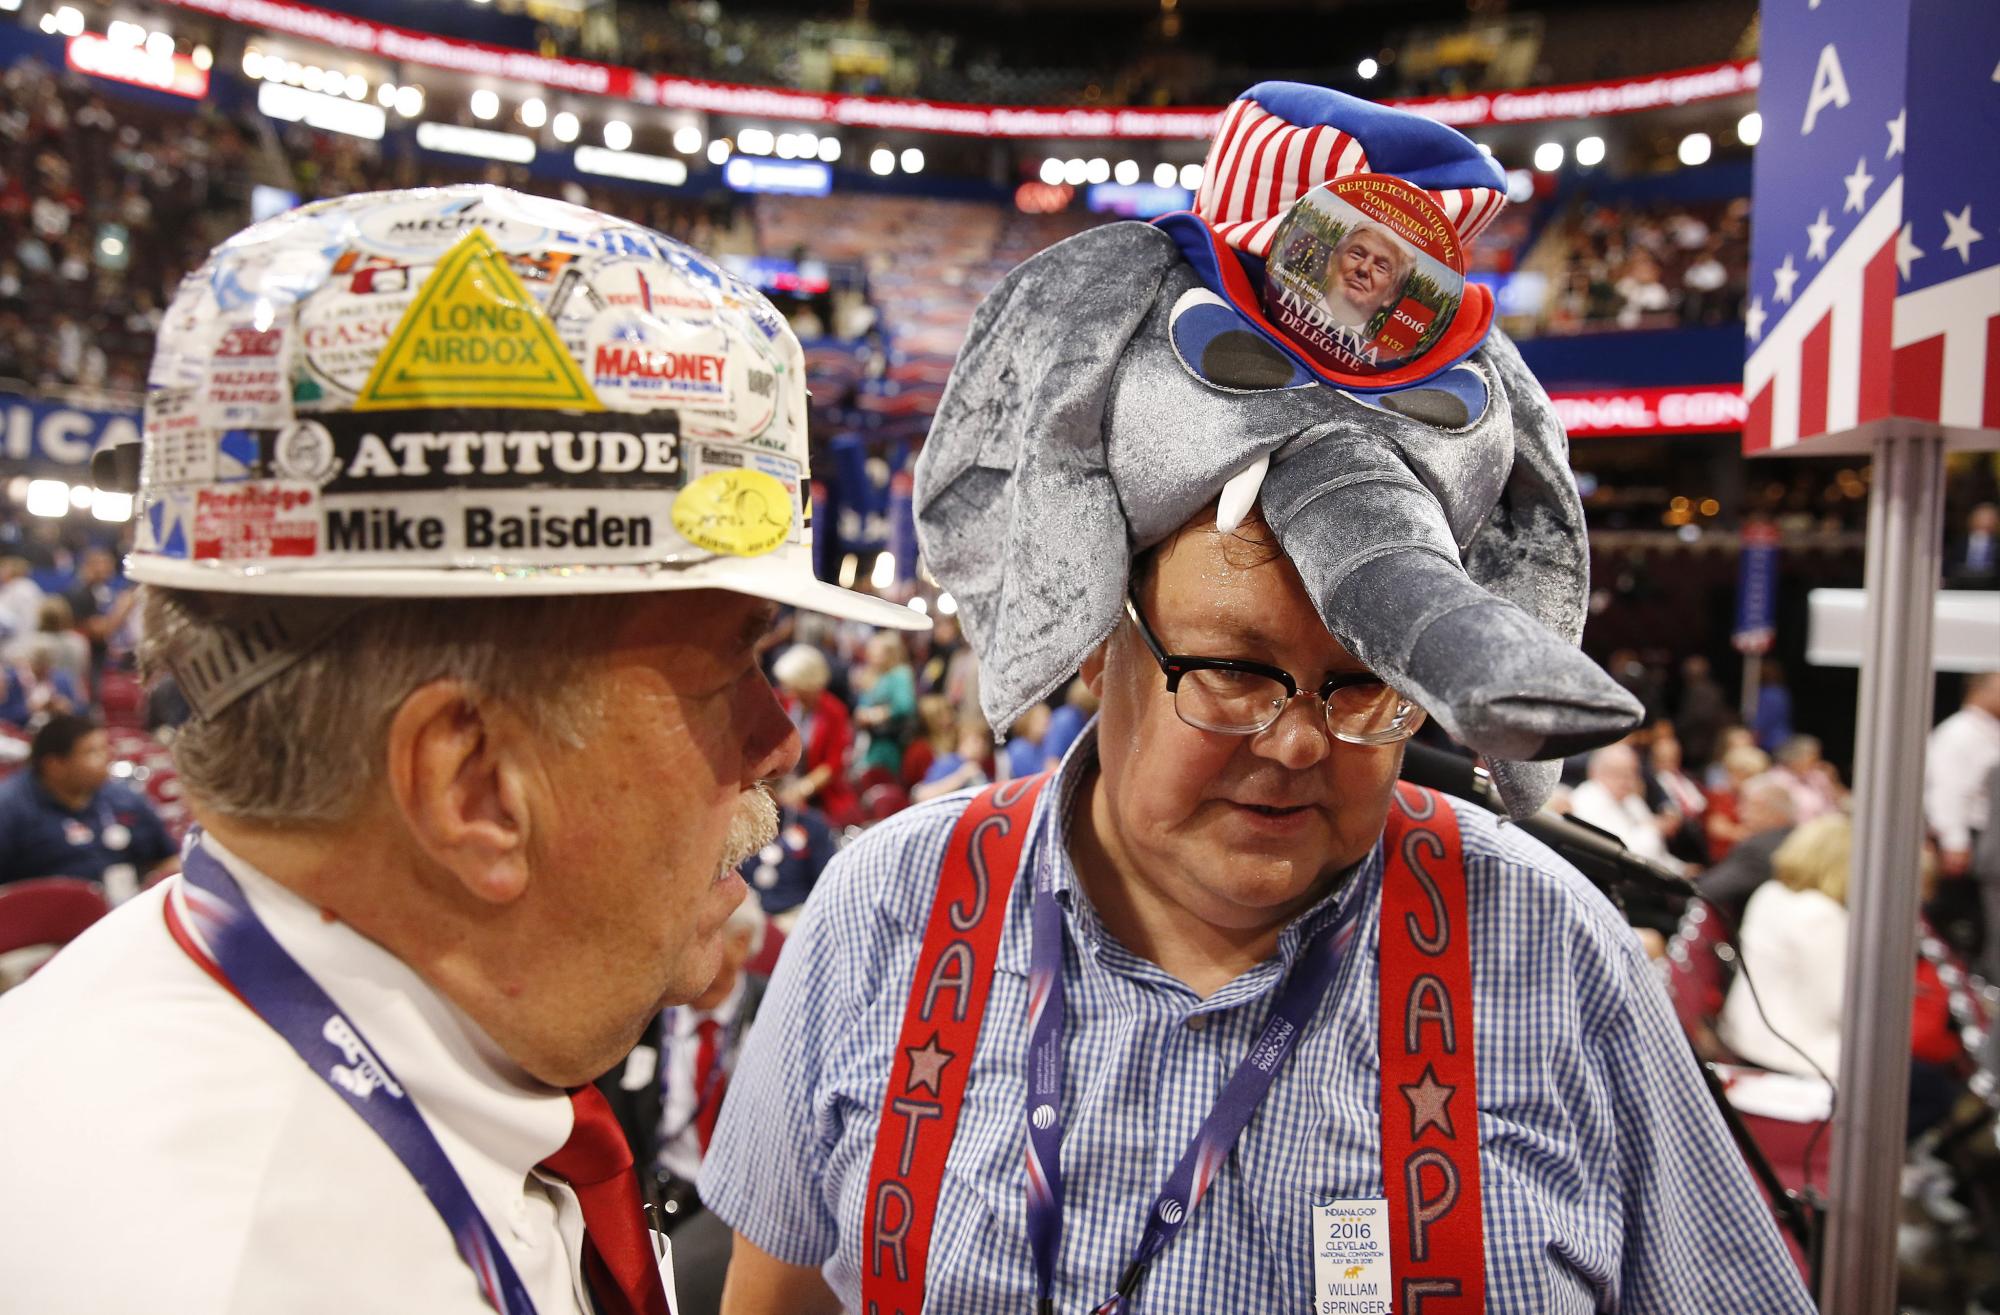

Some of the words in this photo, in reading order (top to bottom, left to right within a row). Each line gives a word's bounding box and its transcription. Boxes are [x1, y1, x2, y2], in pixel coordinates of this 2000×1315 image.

[1338, 180, 1418, 205] REPUBLICAN
[1416, 199, 1456, 262] NATIONAL
[1363, 191, 1437, 242] CONVENTION
[1273, 262, 1302, 287] Donald
[1300, 278, 1325, 300] Trump
[431, 304, 523, 332] LONG
[1277, 286, 1380, 368] INDIANA
[1392, 309, 1427, 334] 2016
[411, 336, 541, 364] AIRDOX
[1279, 310, 1364, 373] DELEGATE
[1380, 333, 1405, 352] #137
[594, 376, 622, 388] FOR
[595, 344, 725, 384] MALONEY
[0, 404, 141, 465] ICA
[346, 430, 679, 478] ATTITUDE
[327, 507, 446, 553] Mike
[464, 506, 652, 550] Baisden
[1251, 1016, 1284, 1065] CLEVELAND
[868, 1097, 942, 1315] TR
[1325, 1241, 1378, 1251] CLEVELAND
[1330, 1223, 1371, 1239] 2016
[1322, 1301, 1386, 1315] SPRINGER
[1328, 1282, 1378, 1296] WILLIAM
